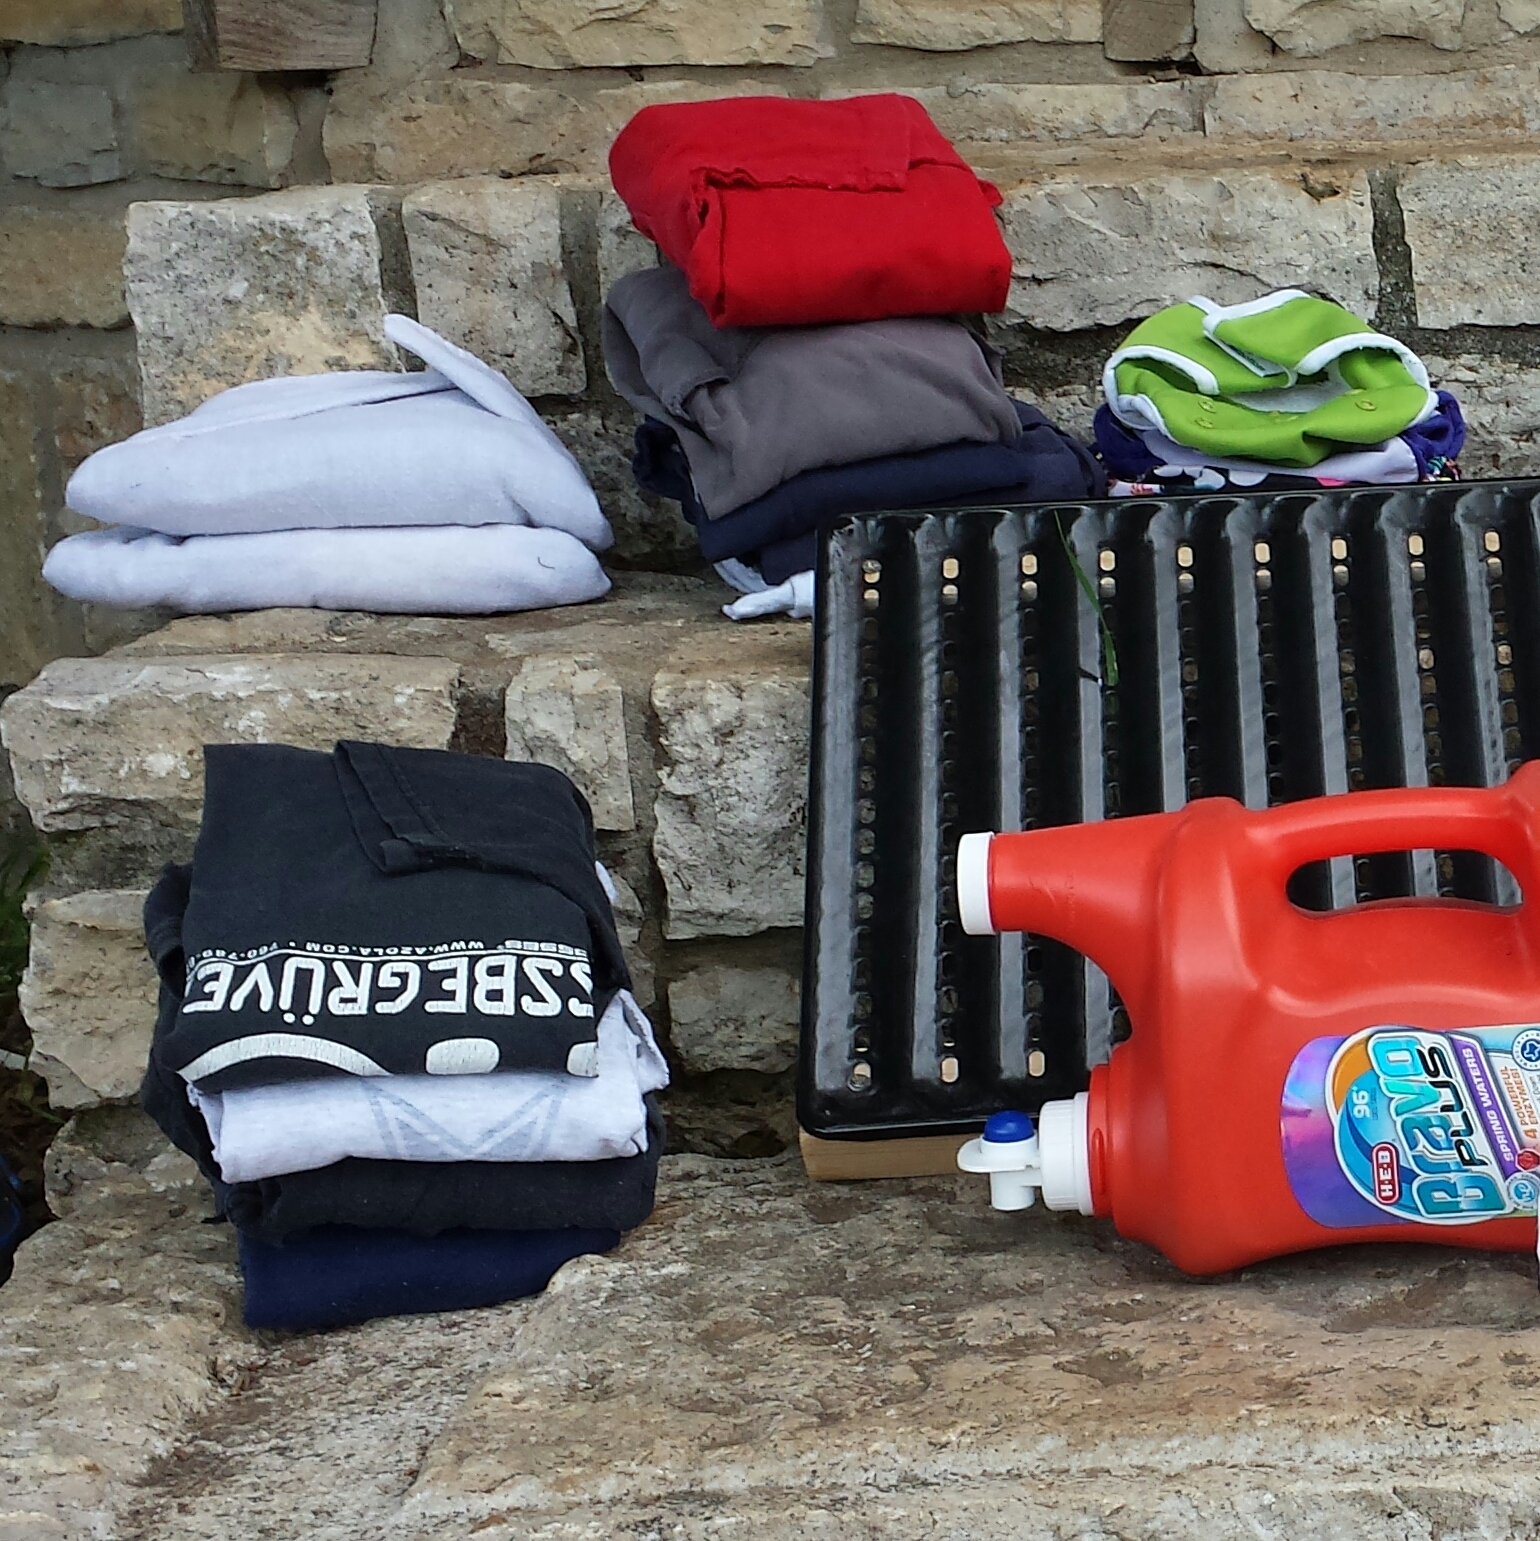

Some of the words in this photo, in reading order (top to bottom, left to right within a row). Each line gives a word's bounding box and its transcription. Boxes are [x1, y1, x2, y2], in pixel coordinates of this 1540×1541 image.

[1416, 1045, 1489, 1167] PLUS
[1462, 1048, 1492, 1108] WATERS
[1500, 1066, 1529, 1126] POWERFUL
[1486, 1109, 1514, 1162] SPRING
[1523, 1128, 1538, 1139] 4
